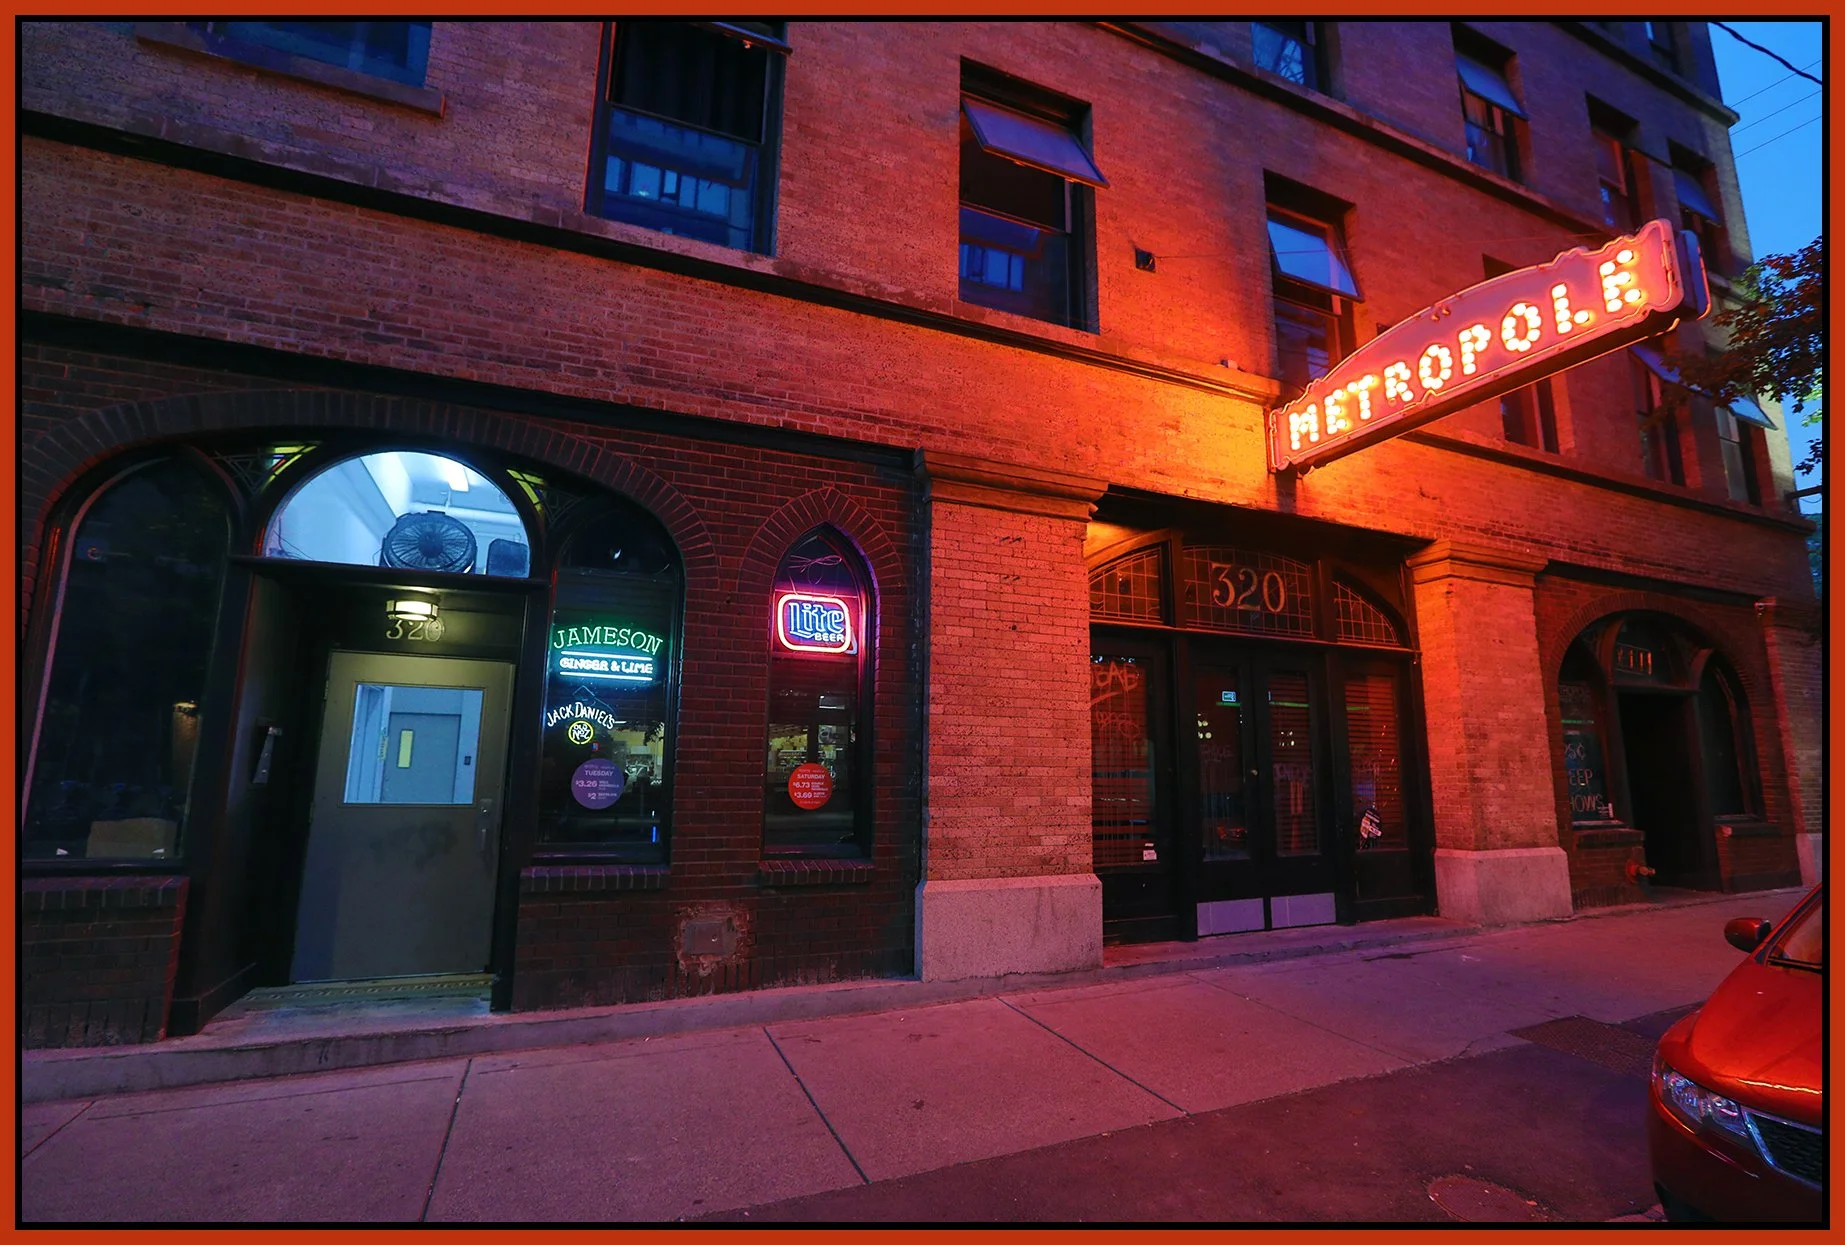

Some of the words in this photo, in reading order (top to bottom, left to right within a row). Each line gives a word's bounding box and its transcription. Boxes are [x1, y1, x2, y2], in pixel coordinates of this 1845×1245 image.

[1288, 249, 1641, 451] METROPOLE
[1211, 563, 1286, 613] 320
[386, 618, 444, 642] 320
[788, 602, 845, 637] Lite
[553, 625, 663, 655] JAMESON
[814, 632, 846, 643] BEER
[559, 657, 609, 672] GINGER
[610, 660, 621, 672] &
[621, 661, 654, 674] LIME
[546, 703, 574, 727] JACK
[584, 769, 614, 777] TUESDAY
[1568, 768, 1593, 786] EEP
